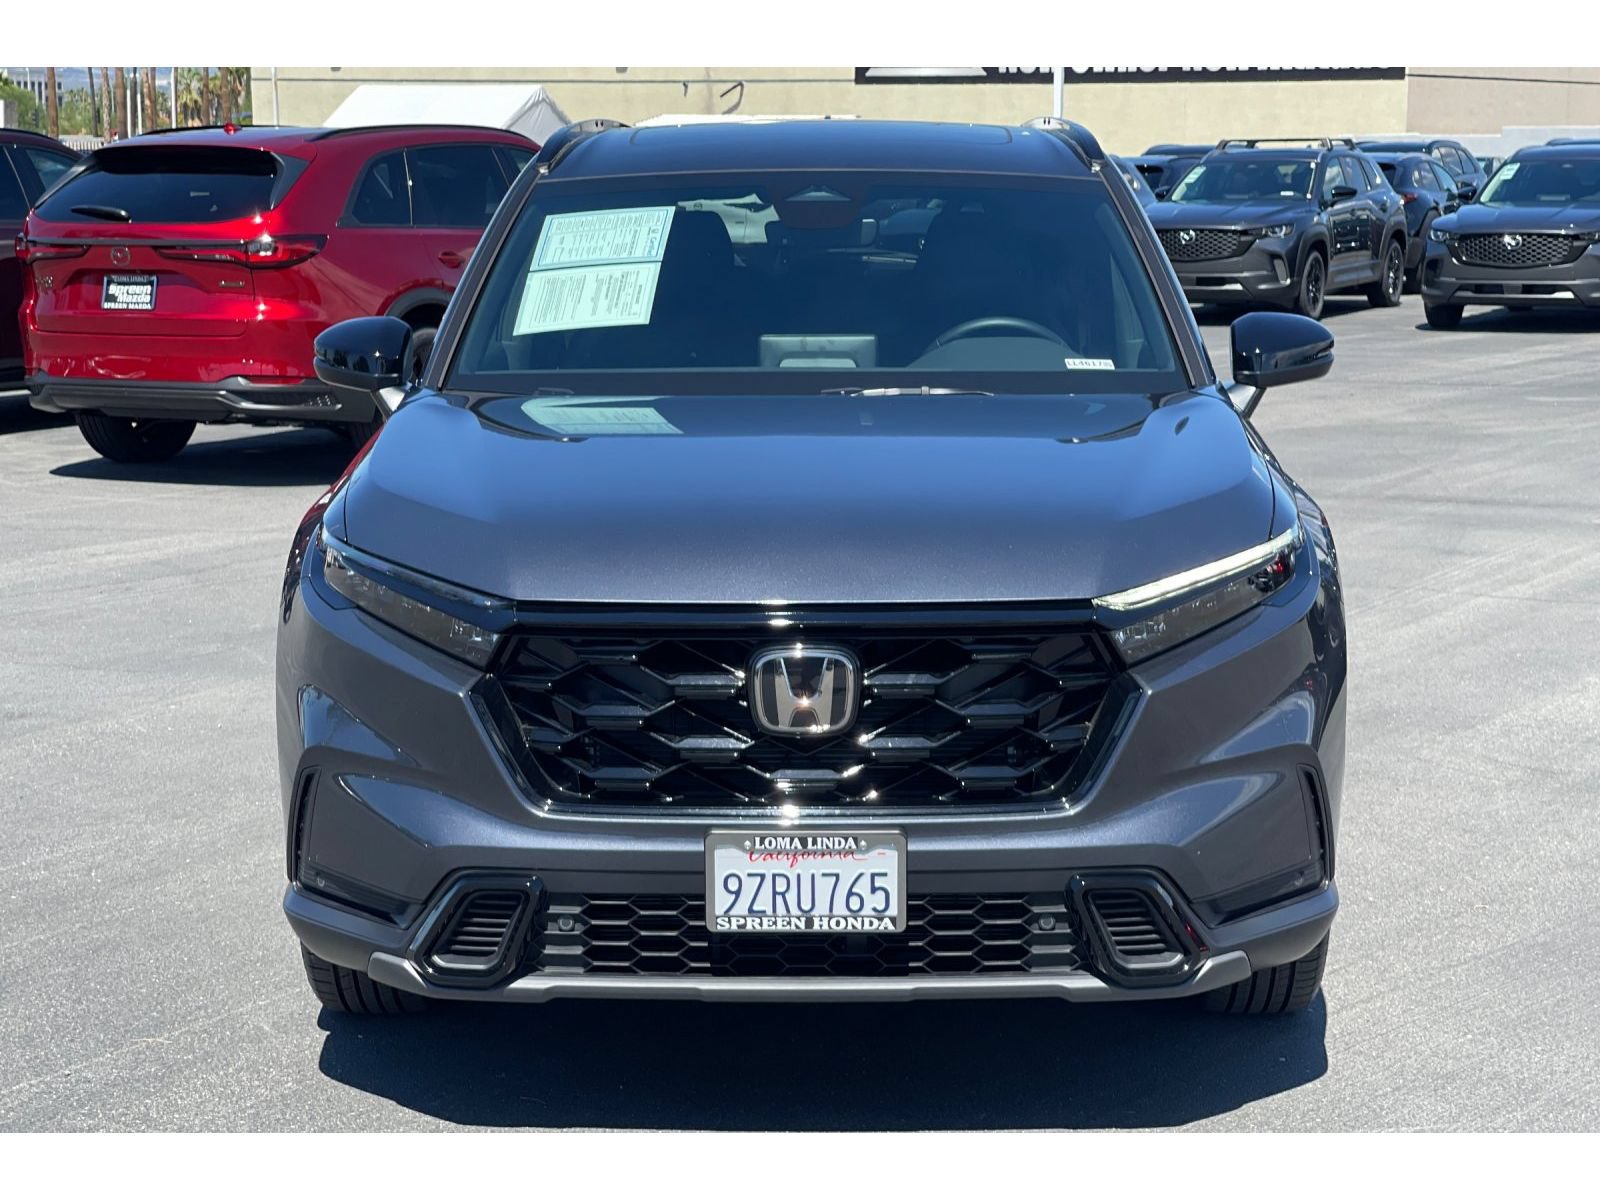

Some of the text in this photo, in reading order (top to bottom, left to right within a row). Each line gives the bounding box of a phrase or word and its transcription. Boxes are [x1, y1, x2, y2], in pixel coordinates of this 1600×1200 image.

[755, 837, 857, 849] LOMA LINDA
[723, 872, 890, 914] 9ZRU765
[716, 916, 896, 930] SPREEN HONDA
